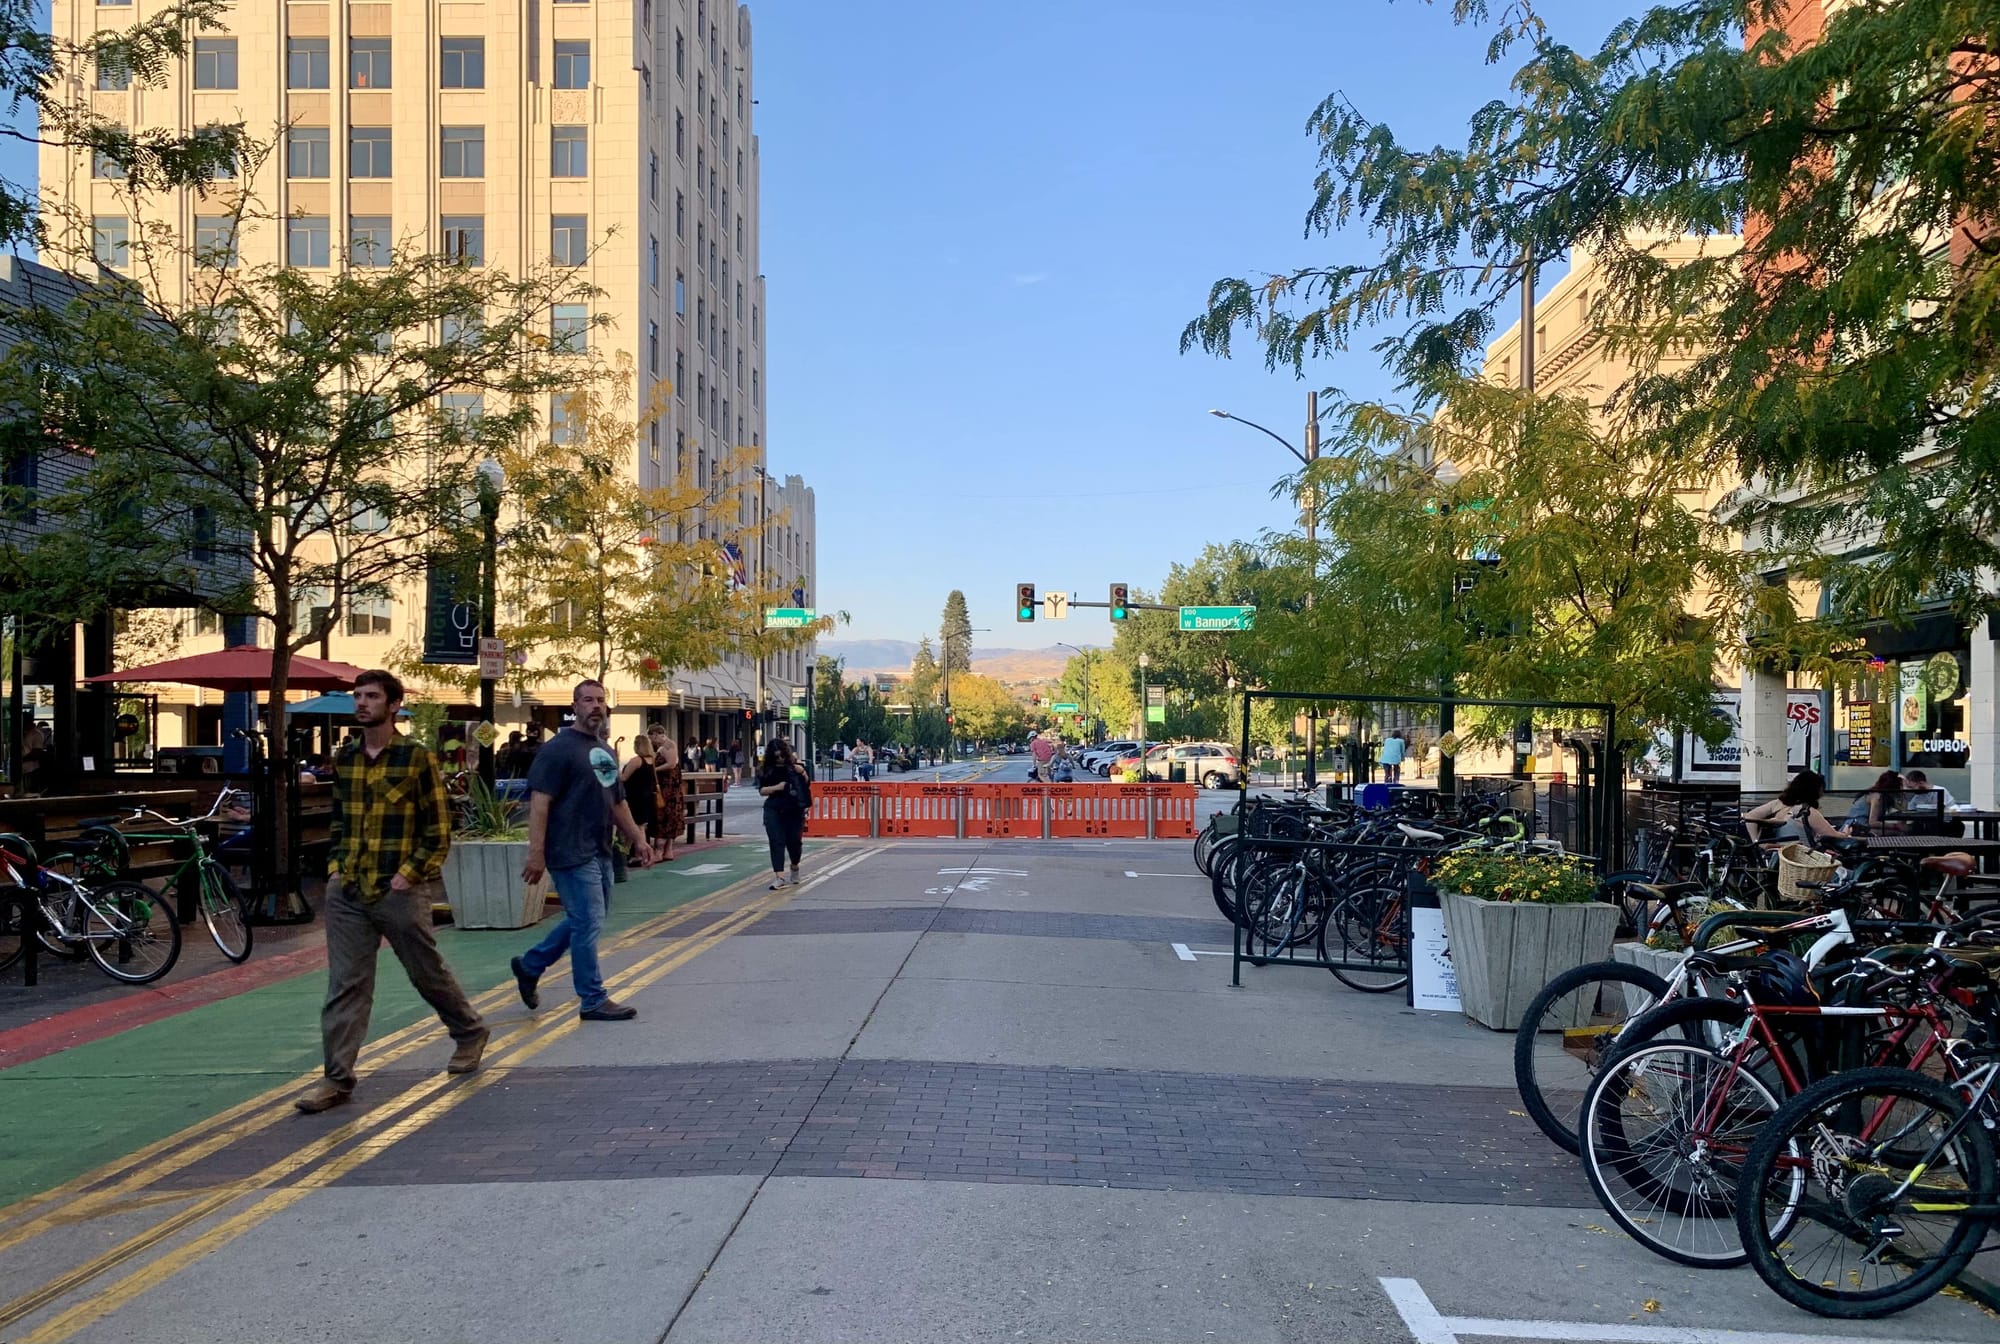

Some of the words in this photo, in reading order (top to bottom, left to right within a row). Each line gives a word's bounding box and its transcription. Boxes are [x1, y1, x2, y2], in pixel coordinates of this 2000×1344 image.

[767, 616, 803, 626] BANNOCK
[1184, 619, 1192, 628] W
[1195, 616, 1240, 628] Bannock
[487, 642, 498, 651] NO
[480, 650, 504, 659] PARKING
[1786, 703, 1821, 724] ISS
[1707, 747, 1742, 755] MONDA
[1923, 739, 1968, 753] CUPBOP
